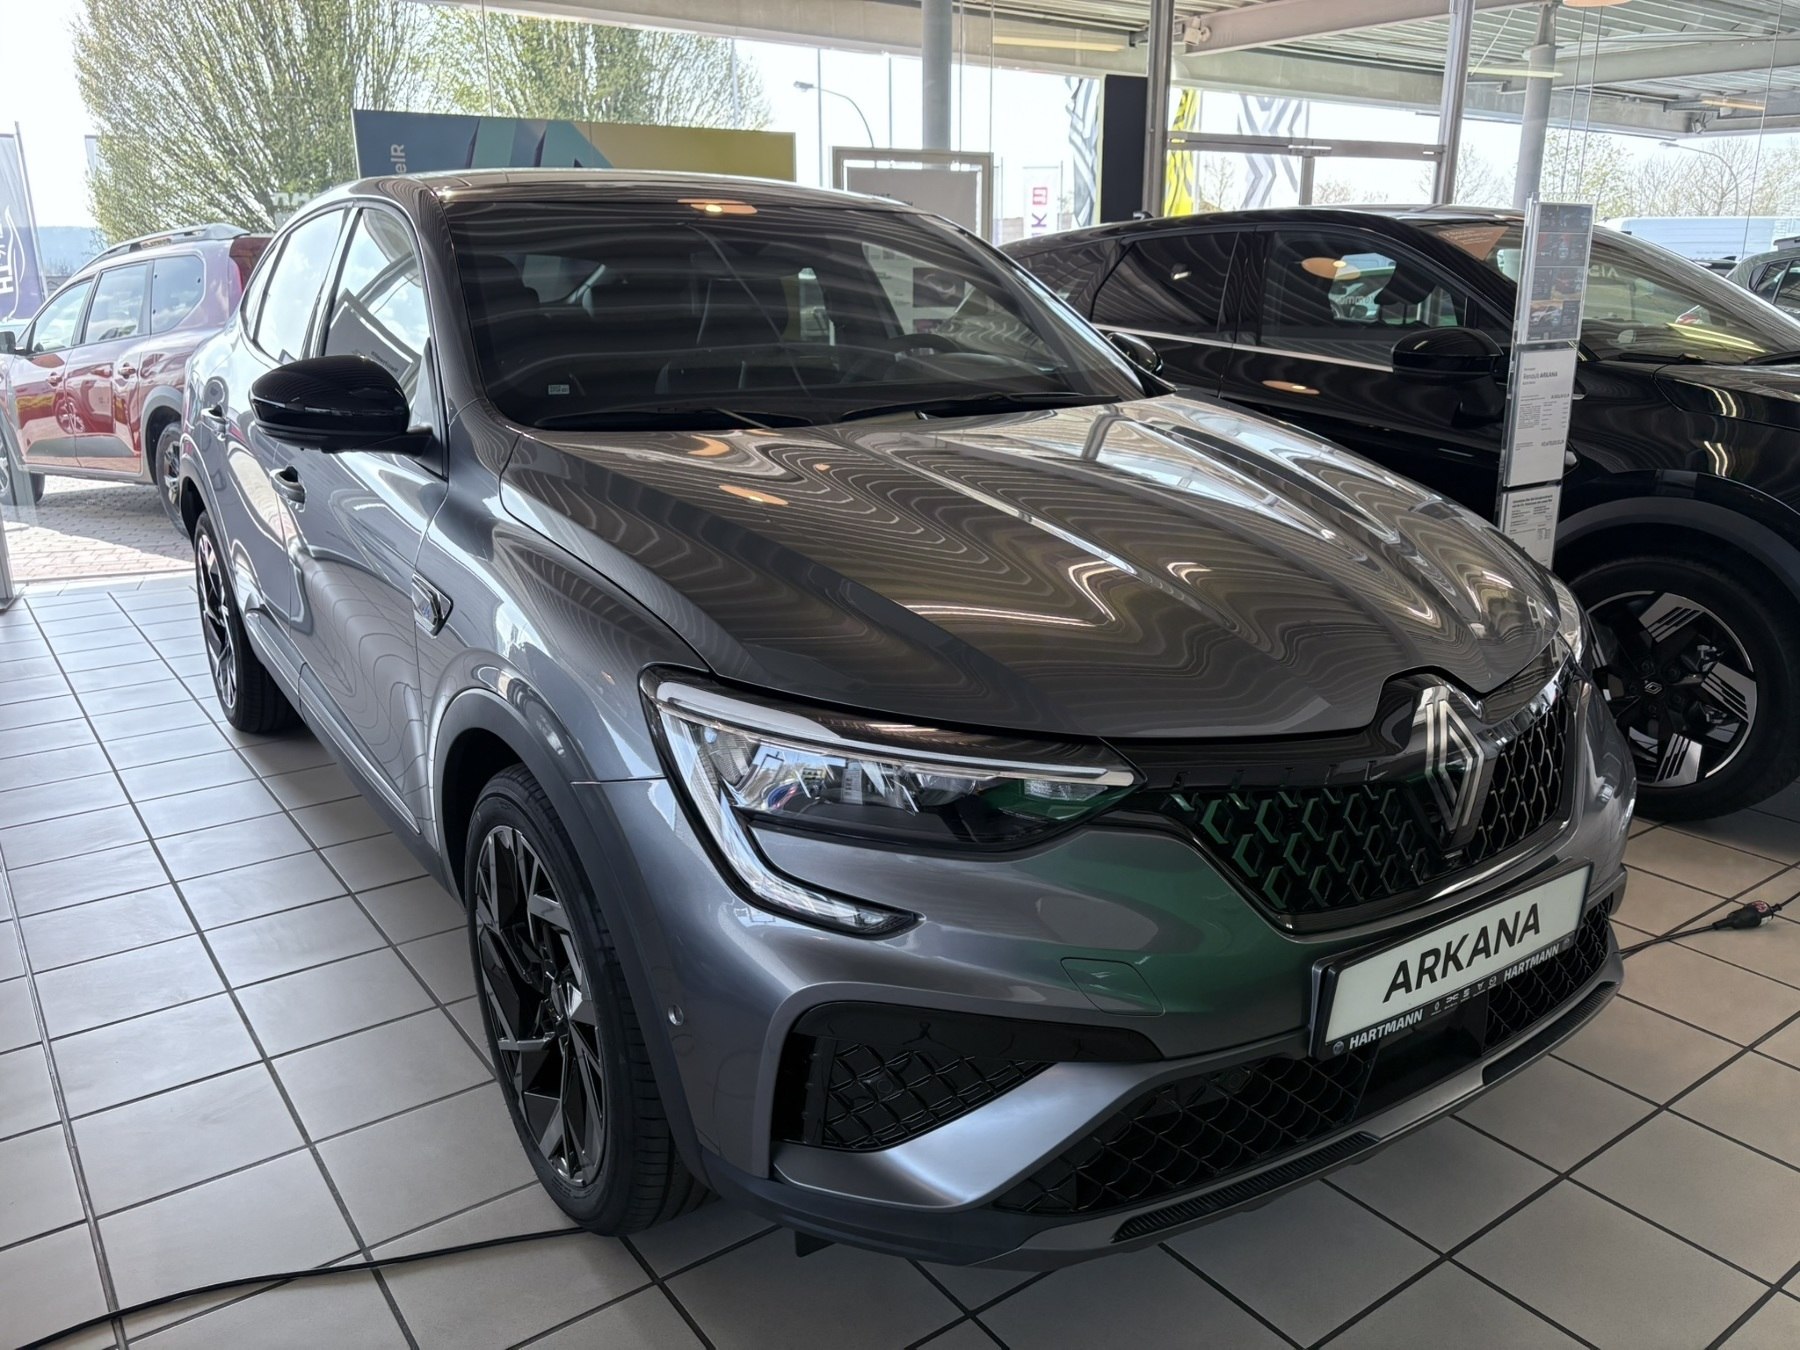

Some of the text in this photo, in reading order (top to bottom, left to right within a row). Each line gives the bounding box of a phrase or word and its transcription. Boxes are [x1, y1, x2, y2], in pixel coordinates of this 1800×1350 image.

[1349, 943, 1560, 1050] HARTMANN HARTMANN
[1383, 902, 1541, 1004] ARKANA
